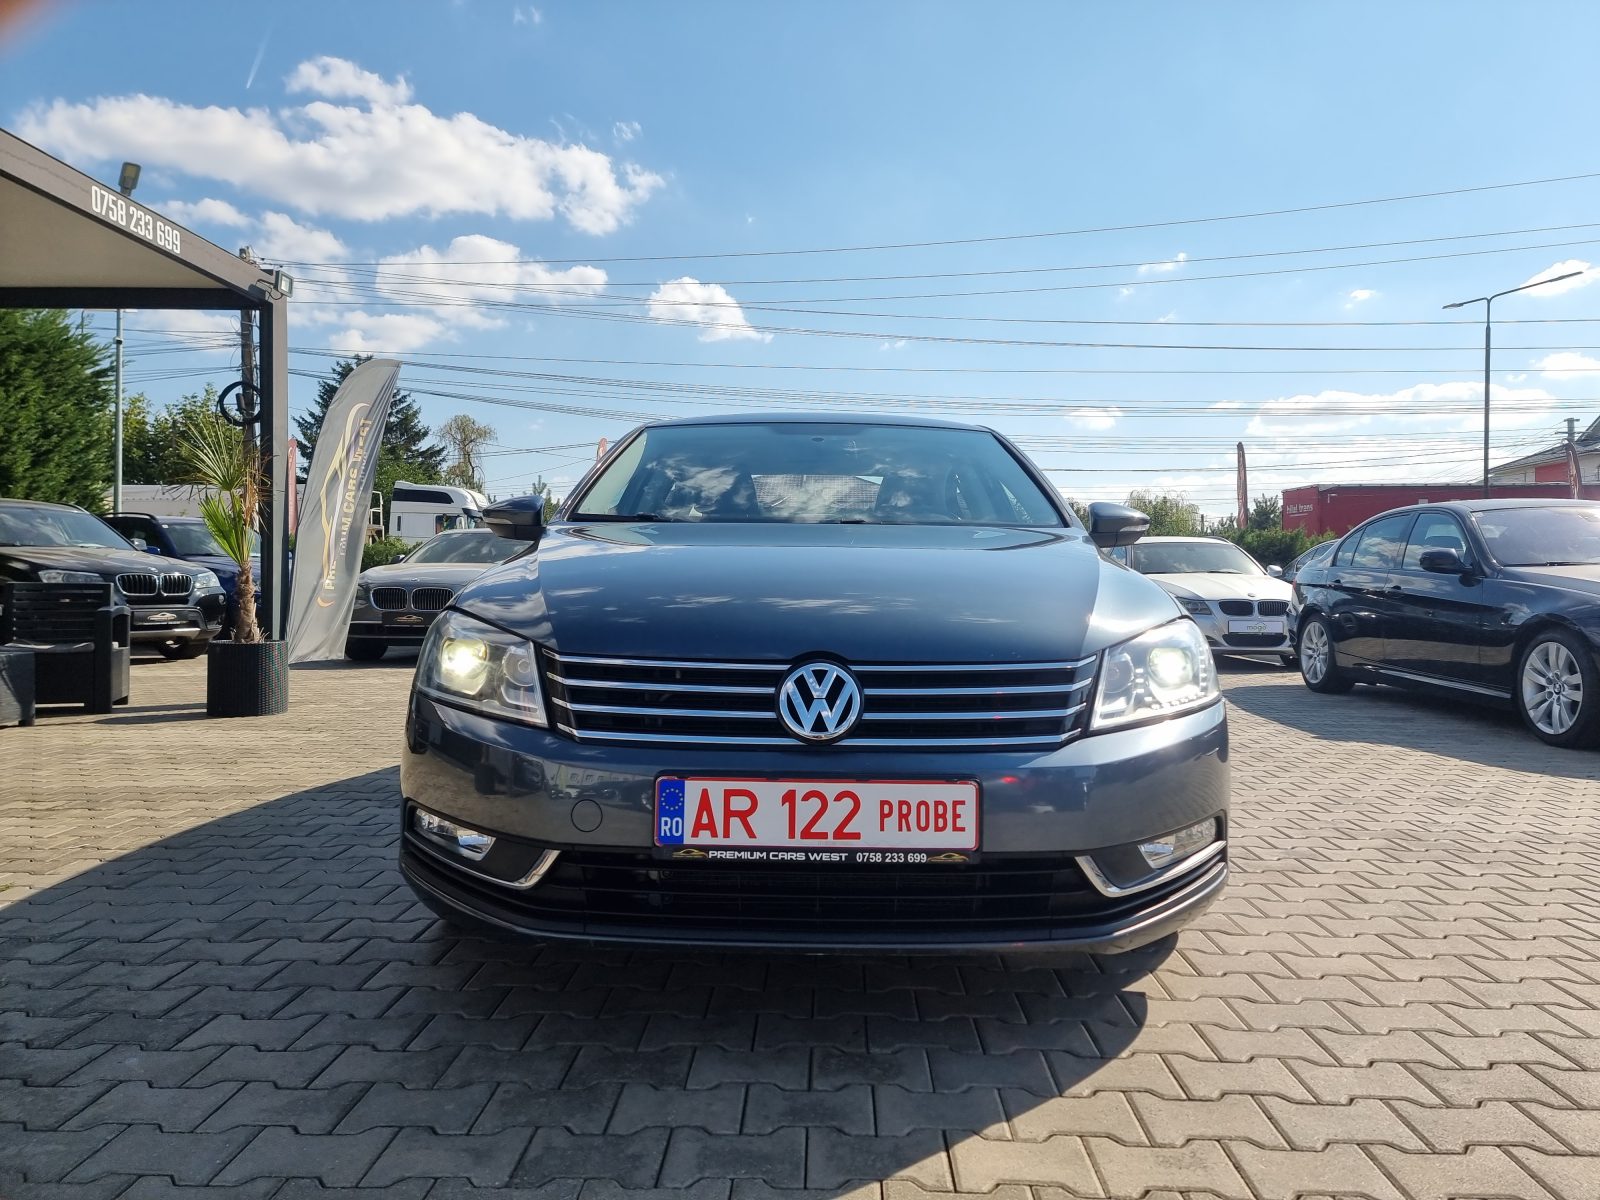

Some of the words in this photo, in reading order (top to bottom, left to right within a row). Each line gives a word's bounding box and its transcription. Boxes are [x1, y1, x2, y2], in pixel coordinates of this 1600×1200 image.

[92, 185, 127, 226] 0758
[129, 206, 153, 240] 233
[156, 221, 180, 254] 699
[323, 517, 352, 590] PREM
[343, 468, 357, 513] CARS
[661, 817, 682, 837] RO
[691, 788, 757, 839] AR
[781, 789, 861, 840] 122
[879, 799, 966, 832] PROBE
[708, 850, 767, 860] PREMIUM
[769, 851, 806, 861] CARS
[808, 852, 849, 861] WEST
[856, 852, 882, 863] 0758
[885, 852, 904, 863] 233
[907, 853, 927, 863] 699
